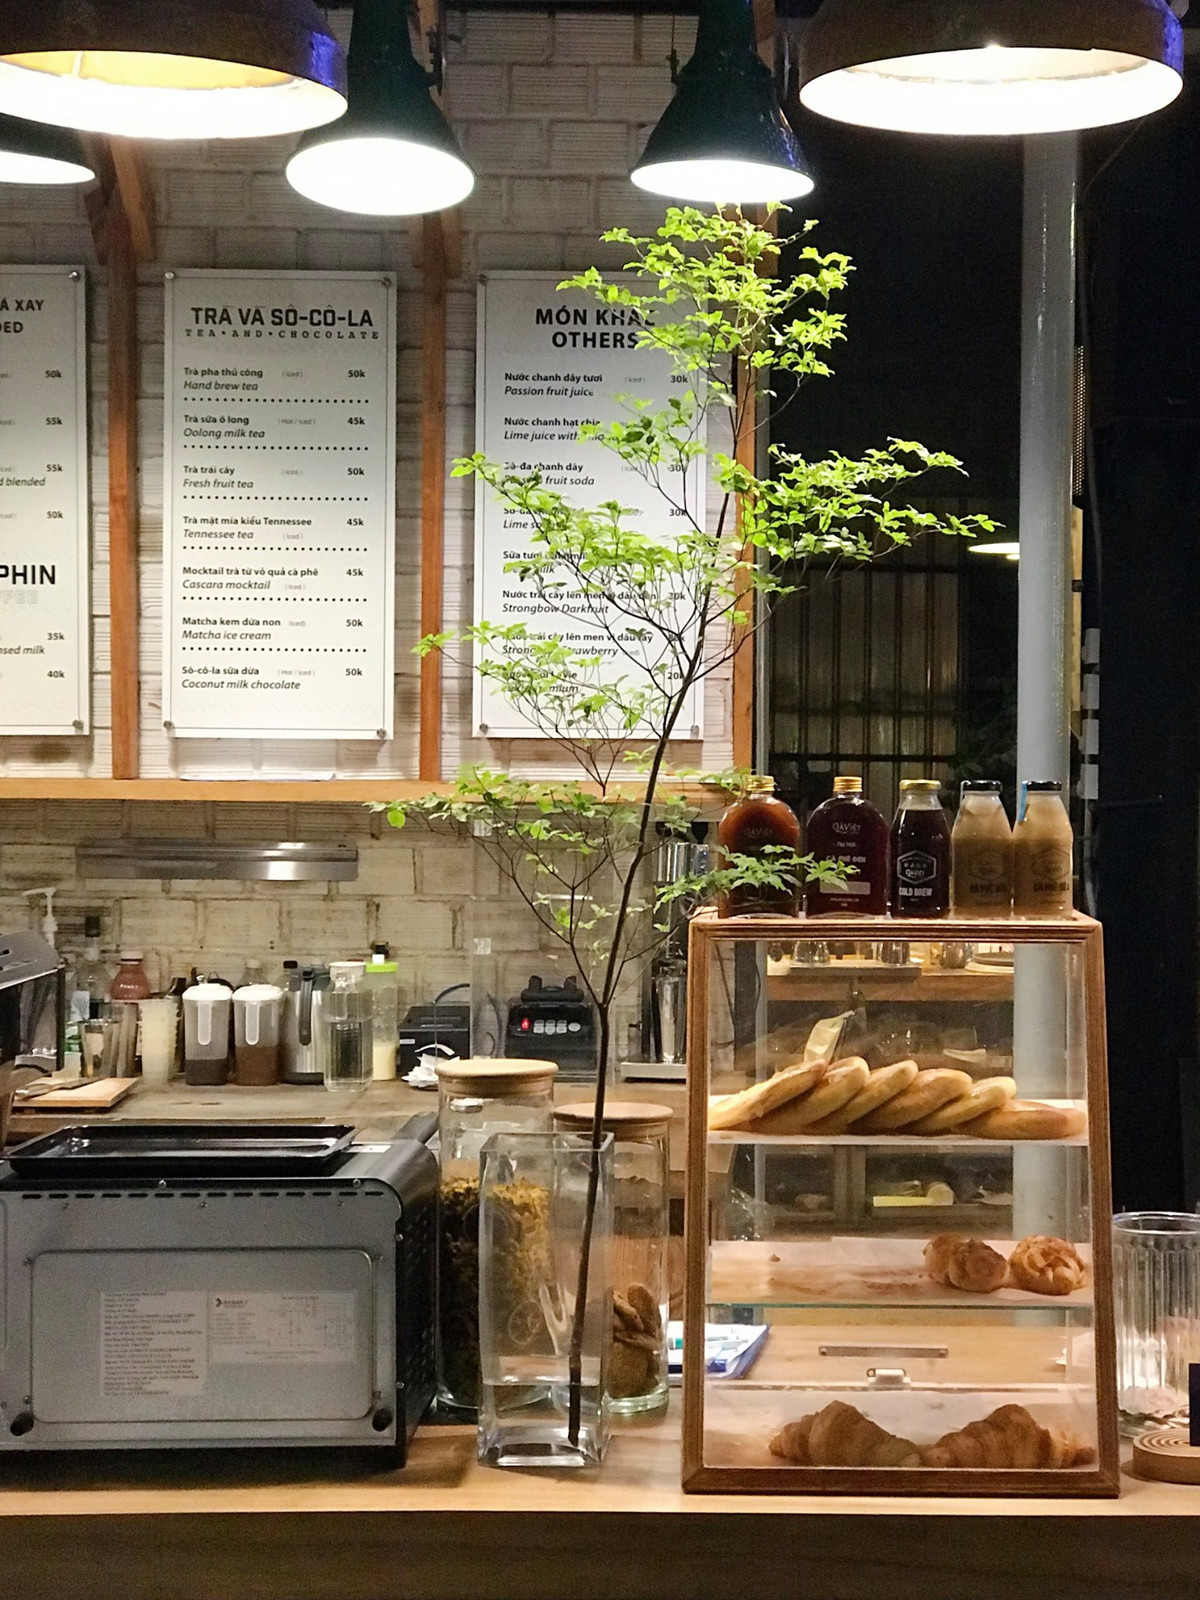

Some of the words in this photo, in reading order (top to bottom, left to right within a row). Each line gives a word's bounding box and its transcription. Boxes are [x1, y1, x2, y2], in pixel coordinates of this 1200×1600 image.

[15, 299, 44, 312] XAY
[271, 302, 374, 328] SÔ-CÔ-LA
[535, 304, 588, 326] MÓN
[184, 328, 217, 338] TEA
[231, 329, 264, 339] AND
[278, 330, 380, 341] CHOCOLATE
[551, 330, 639, 349] OTHERS
[45, 370, 63, 379] 50k
[183, 367, 199, 377] Trà
[200, 367, 220, 379] pha
[347, 369, 366, 379] 50k
[504, 372, 530, 383] Nước
[531, 373, 562, 383] chanh
[670, 374, 689, 384] 30k
[183, 380, 212, 391] Hand
[213, 381, 241, 391] brew
[241, 381, 259, 392] tea
[504, 385, 545, 396] Passion
[546, 386, 569, 397] fruit
[45, 417, 63, 426] 55k
[183, 414, 199, 424] Trà
[227, 415, 250, 426] long
[347, 416, 366, 426] 45k
[504, 417, 529, 427] Nước
[531, 418, 561, 427] chanh
[183, 428, 222, 440] Oolong
[223, 428, 247, 439] milk
[248, 429, 265, 439] tea
[504, 430, 530, 441] Lime
[530, 431, 556, 443] juice
[46, 464, 64, 473] 55k
[183, 465, 199, 475] Trà
[200, 465, 217, 475] trái
[347, 467, 365, 476] 50k
[6, 476, 46, 487] blended
[183, 478, 211, 489] Fresh
[212, 478, 235, 490] fruit
[237, 480, 254, 489] tea
[545, 475, 568, 486] fruit
[569, 476, 595, 486] soda
[46, 511, 64, 519] 50k
[183, 515, 199, 525] Trà
[263, 516, 312, 527] Tennessee
[346, 518, 365, 527] 45k
[503, 519, 529, 529] Lime
[183, 529, 236, 540] Tennessee
[237, 530, 254, 540] tea
[182, 566, 224, 576] Mocktail
[226, 567, 240, 577] trà
[346, 568, 364, 578] 45k
[182, 580, 224, 590] Cascara
[225, 579, 271, 591] mocktail
[502, 590, 528, 600] Nước
[502, 603, 560, 616] Strongbow
[181, 617, 218, 627] Matcha
[219, 617, 240, 627] kem
[262, 619, 281, 627] non
[345, 618, 364, 628] 50k
[47, 632, 65, 641] 35k
[181, 630, 222, 641] Matcha
[223, 631, 238, 641] ice
[239, 632, 272, 641] cream
[583, 633, 605, 641] men
[22, 644, 45, 655] milk
[47, 670, 65, 679] 40k
[345, 667, 363, 677] 50k
[181, 678, 225, 690] Coconut
[226, 679, 250, 690] milk
[250, 679, 301, 691] chocolate
